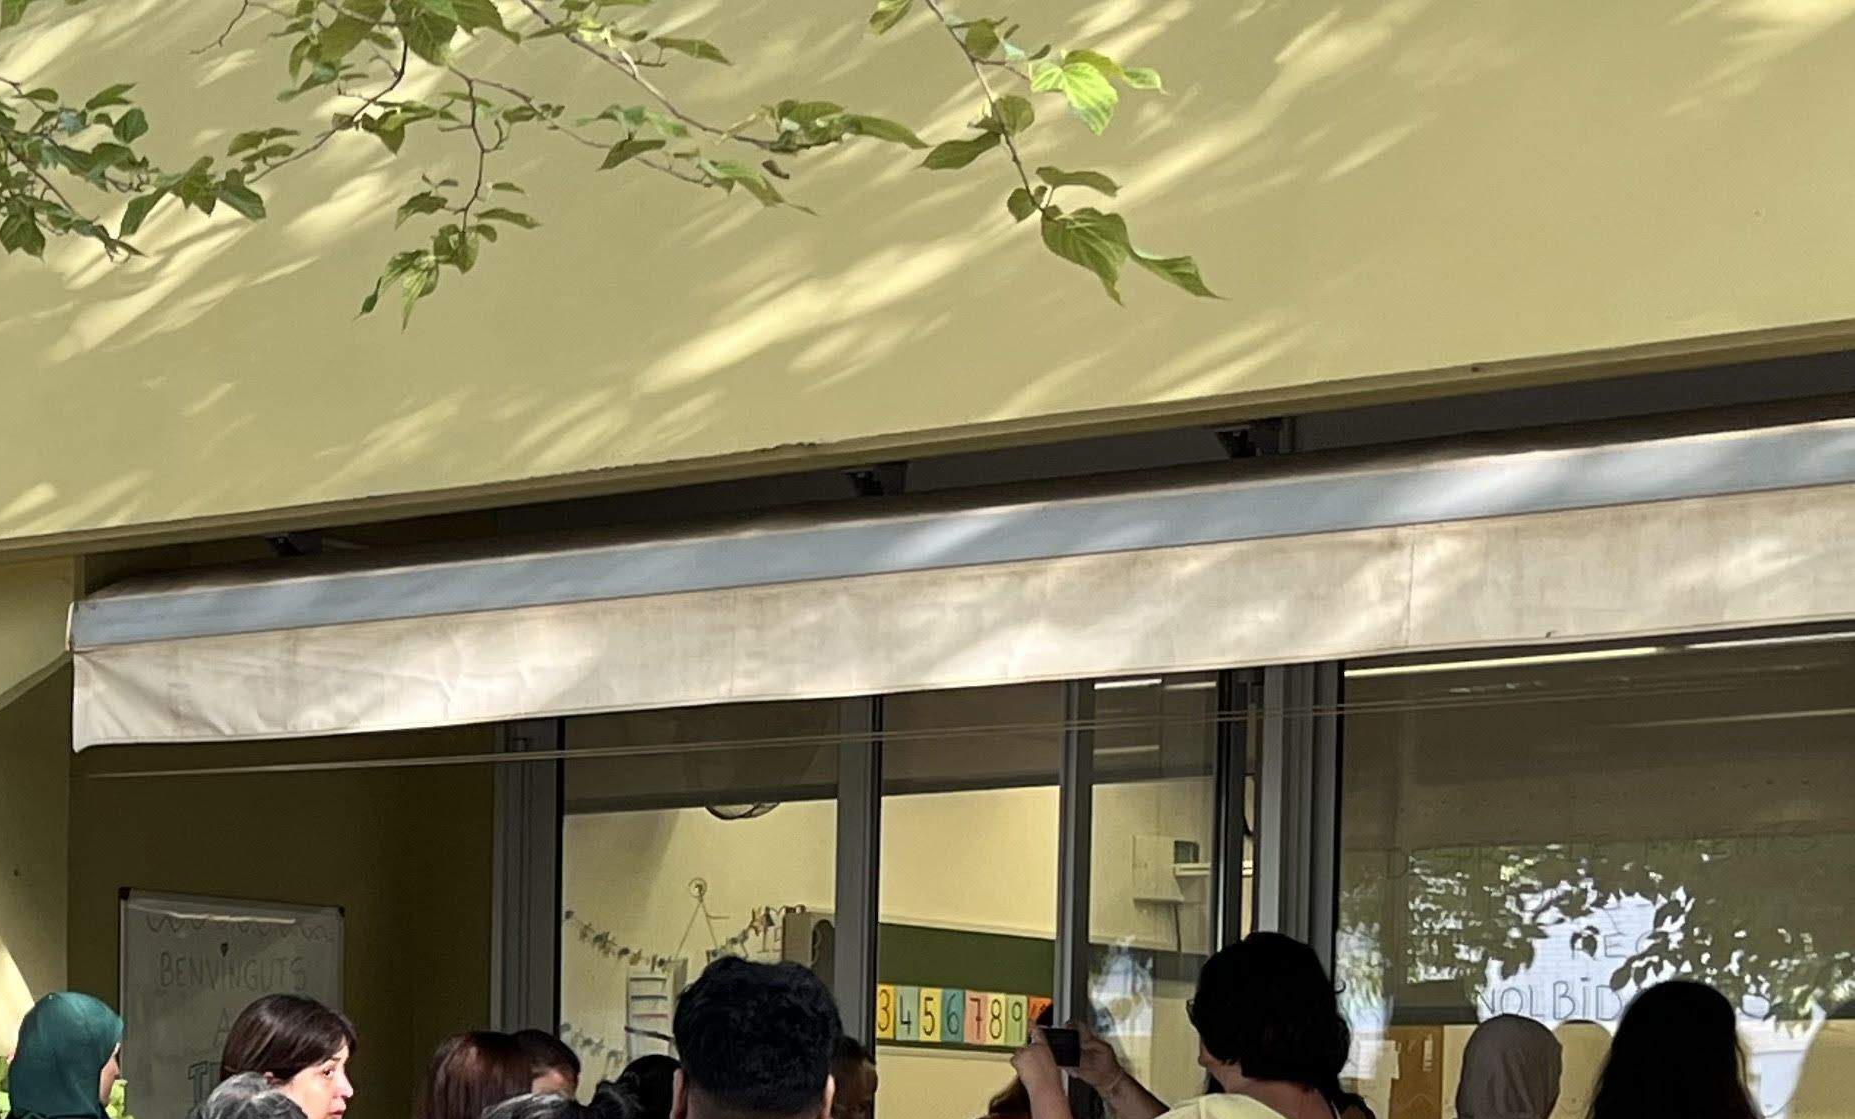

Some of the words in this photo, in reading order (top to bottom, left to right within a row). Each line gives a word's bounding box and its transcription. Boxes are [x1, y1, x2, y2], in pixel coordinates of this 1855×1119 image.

[159, 951, 307, 991] BENVINGUTS
[876, 988, 891, 1033] 3
[899, 993, 912, 1036] 4
[922, 996, 936, 1037] 5
[946, 992, 960, 1036] 6
[969, 997, 983, 1041] 7
[989, 998, 1003, 1041] 8
[1011, 1001, 1024, 1044] 9
